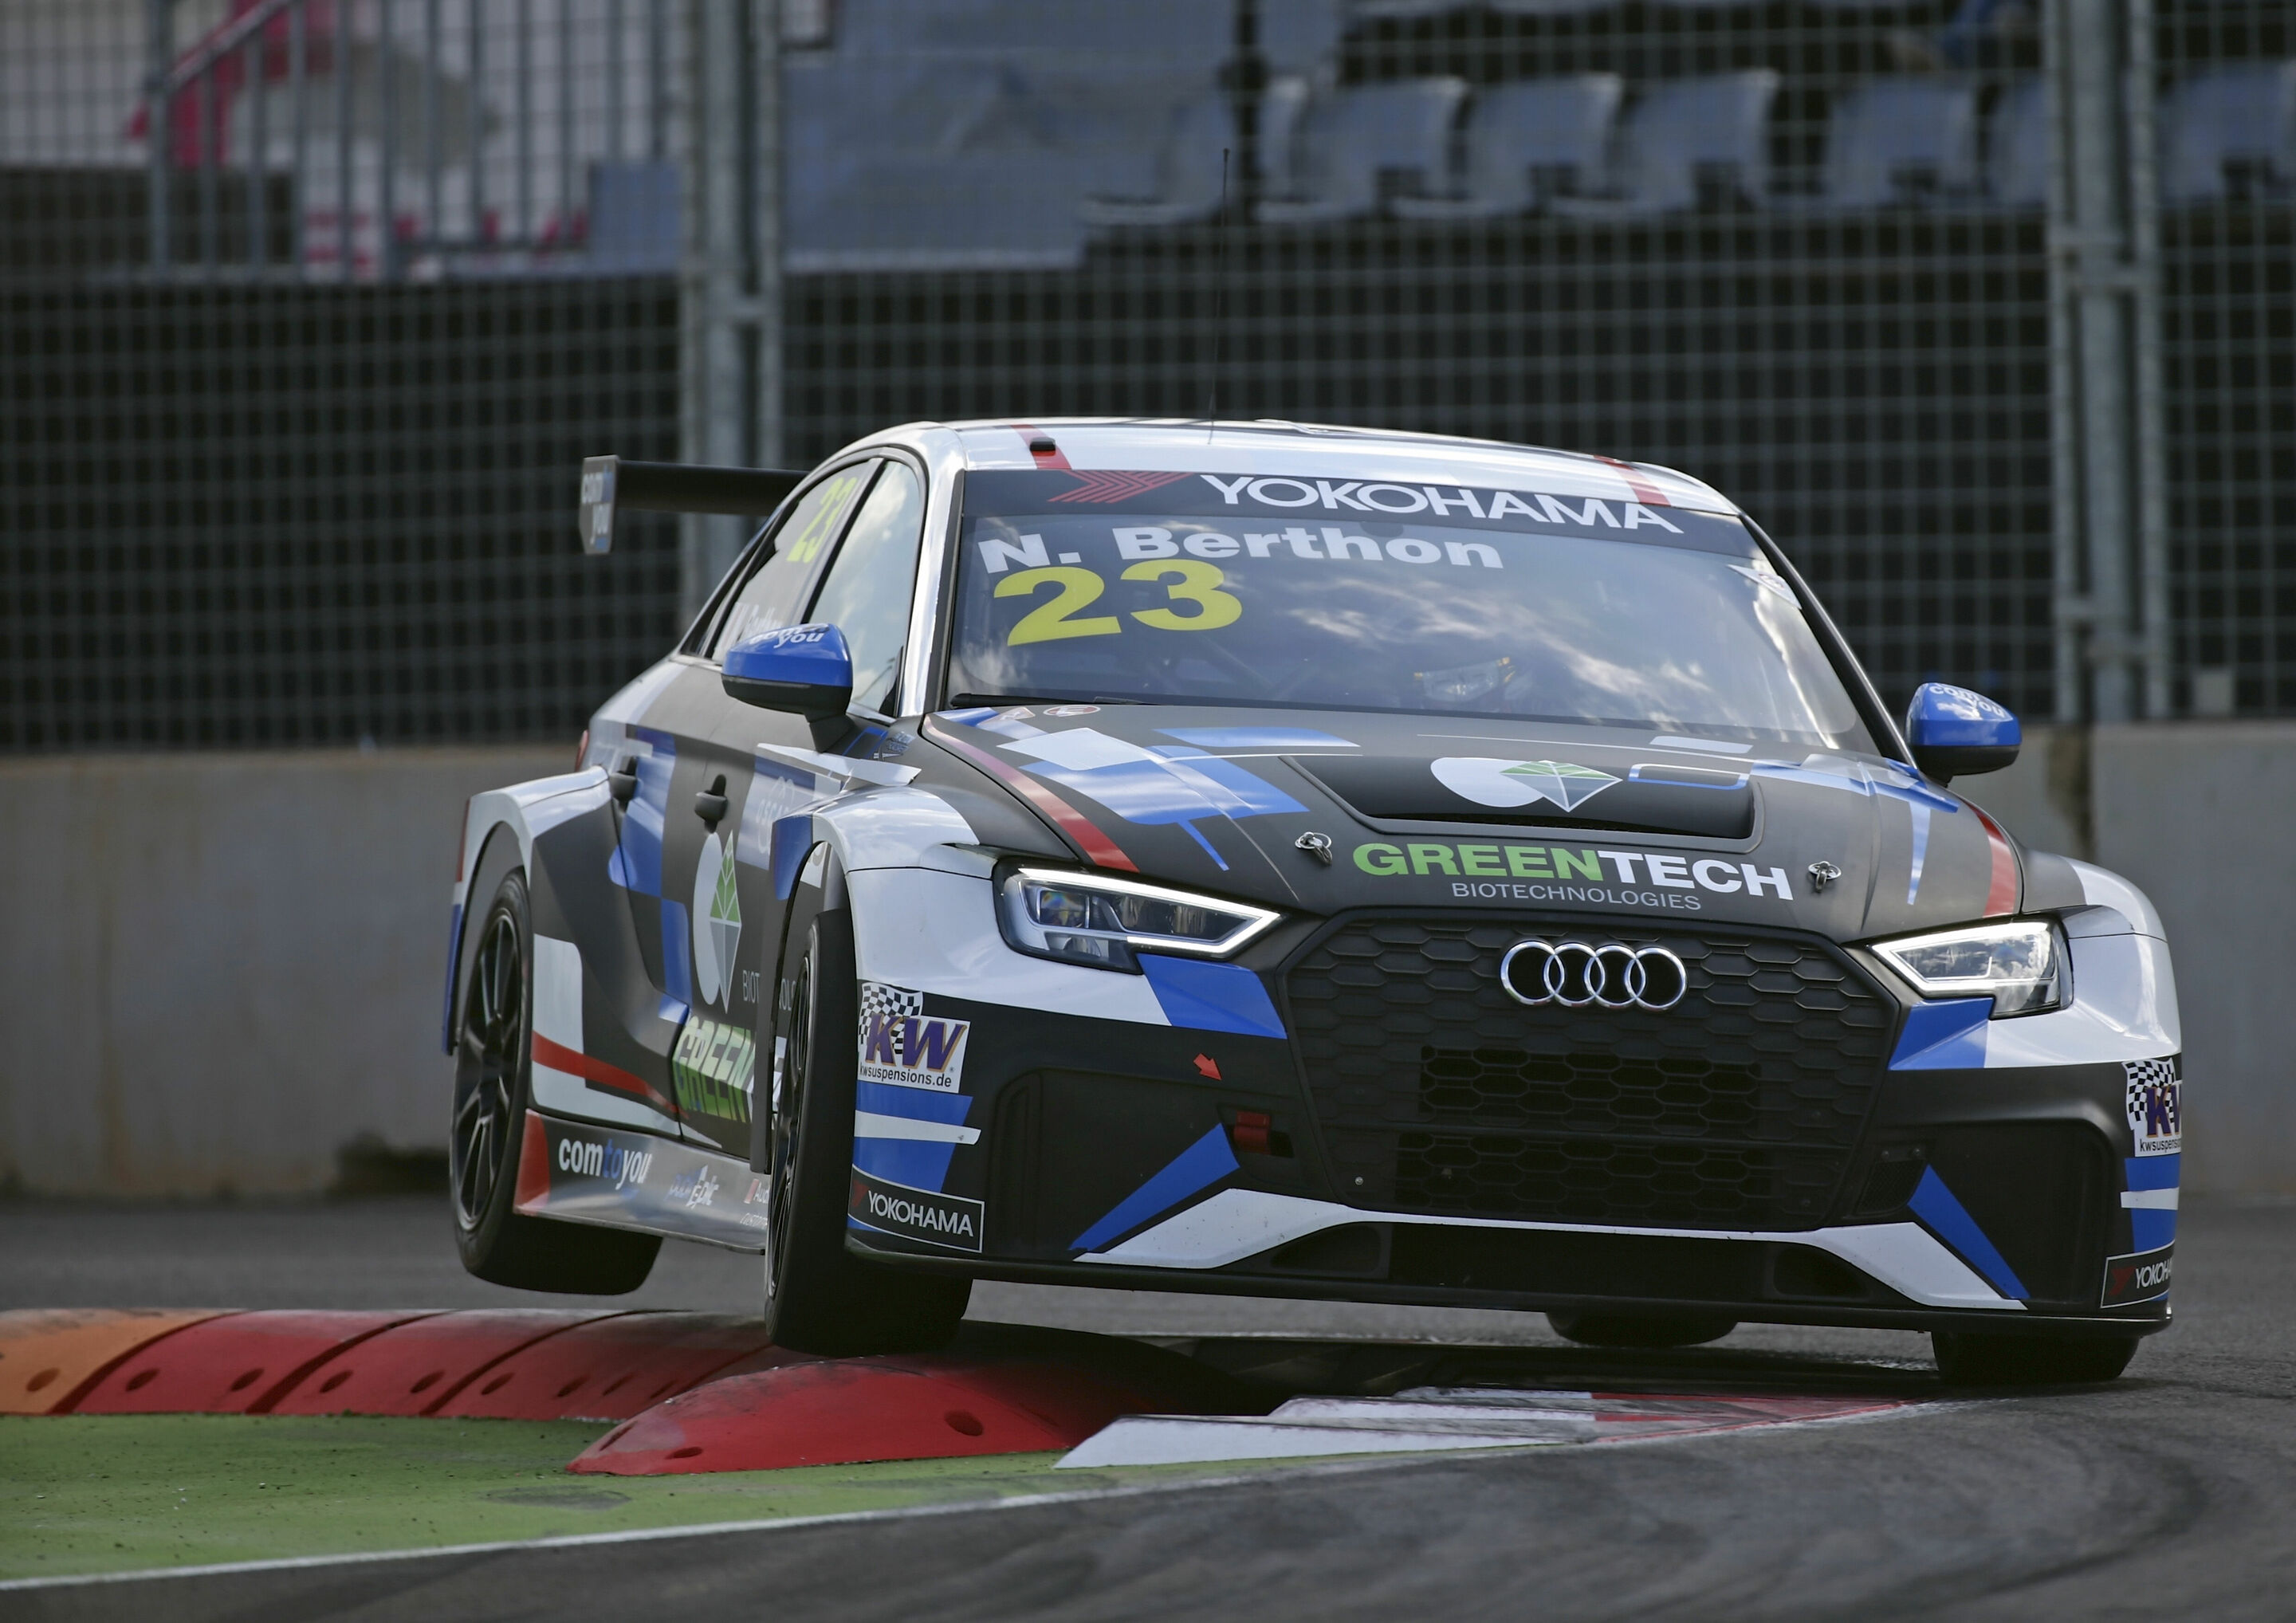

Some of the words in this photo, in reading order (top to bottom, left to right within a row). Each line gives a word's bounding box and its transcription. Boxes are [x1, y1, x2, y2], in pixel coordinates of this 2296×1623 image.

[786, 477, 858, 564] 23
[1200, 474, 1685, 534] YOKOHAMA
[978, 533, 1082, 574] N.
[1112, 526, 1504, 569] Berthon
[993, 558, 1243, 646] 23
[773, 632, 824, 649] you
[1354, 843, 1794, 901] GREENTECH
[1453, 882, 1702, 910] BIOTECHNOLOGIES
[742, 969, 761, 1004] BIOT
[865, 1012, 968, 1073] KW
[859, 1064, 952, 1087] kwsuspensions.de
[868, 1189, 973, 1237] YOKOHAMA
